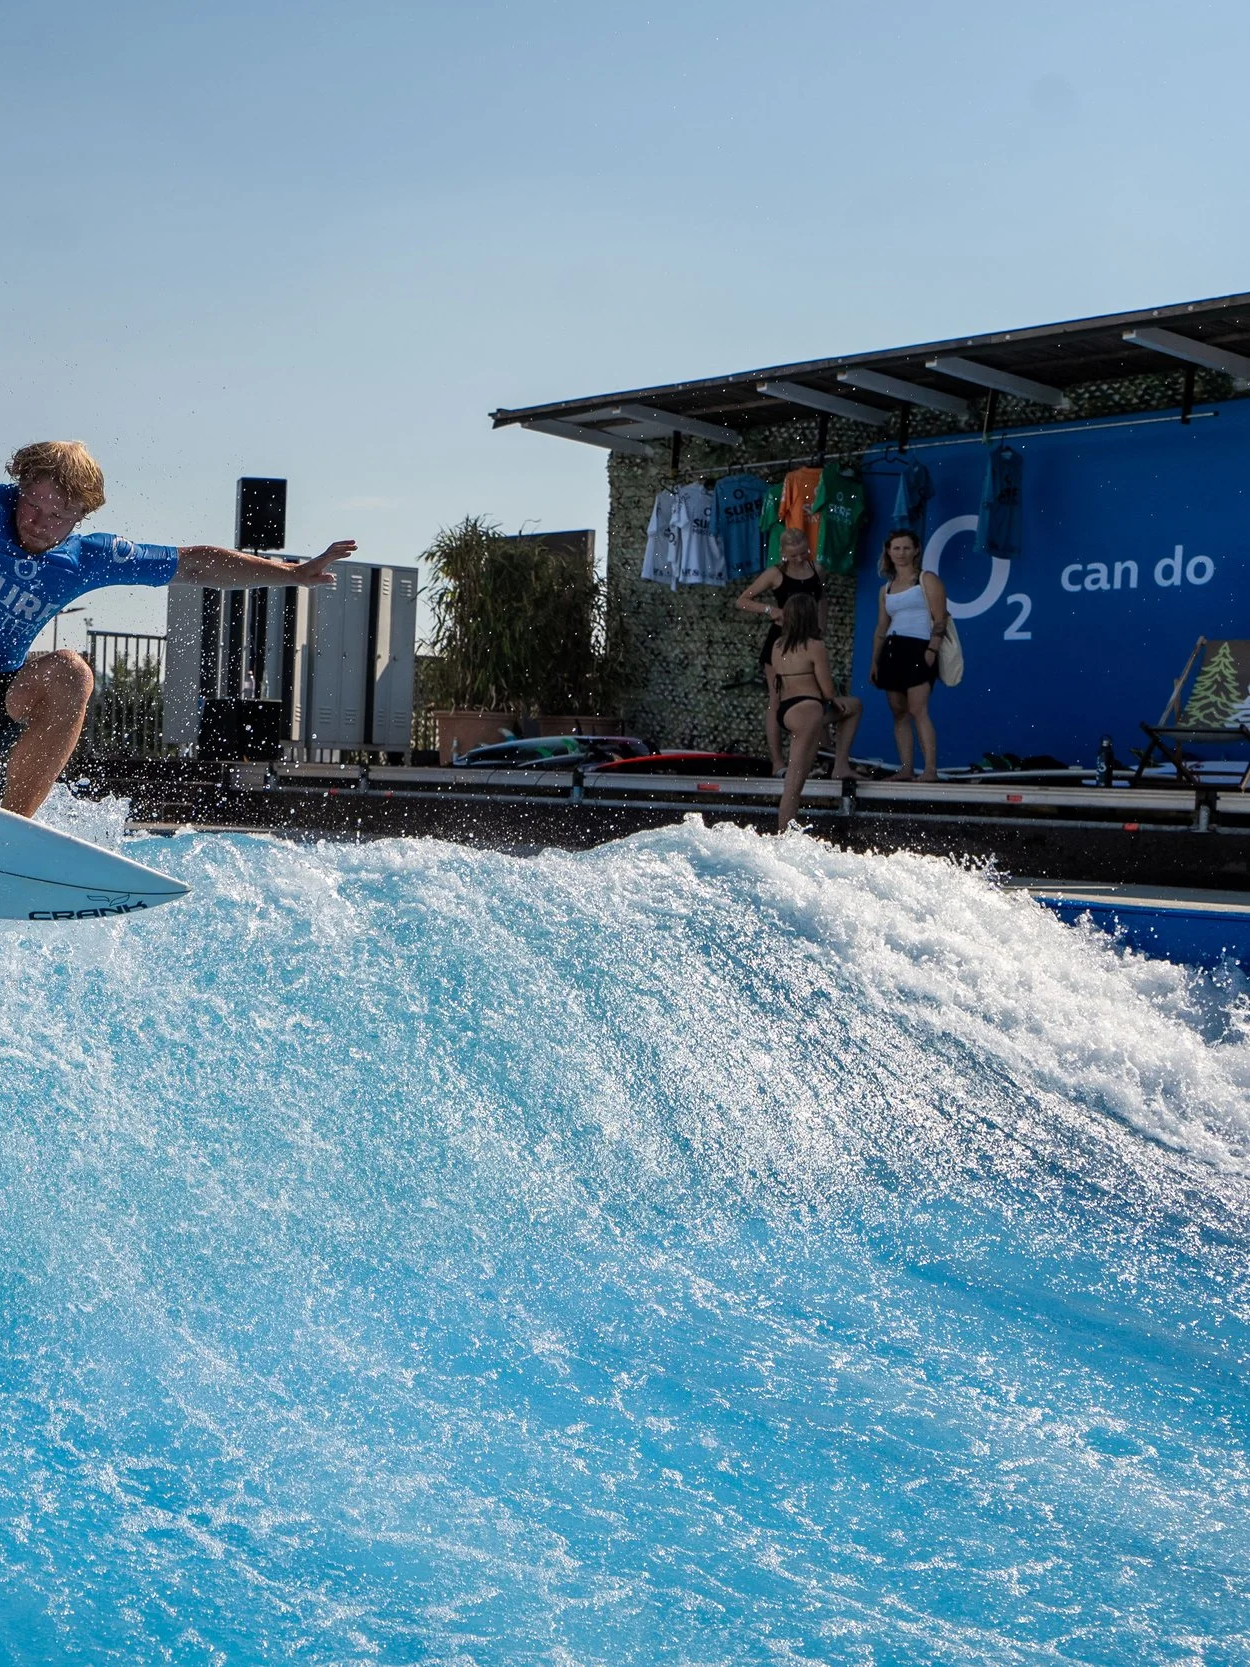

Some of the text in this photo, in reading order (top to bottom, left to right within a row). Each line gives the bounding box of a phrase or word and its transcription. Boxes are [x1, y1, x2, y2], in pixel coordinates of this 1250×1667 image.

[1061, 555, 1138, 593] can
[1154, 544, 1215, 588] do
[28, 900, 148, 920] CRANK
